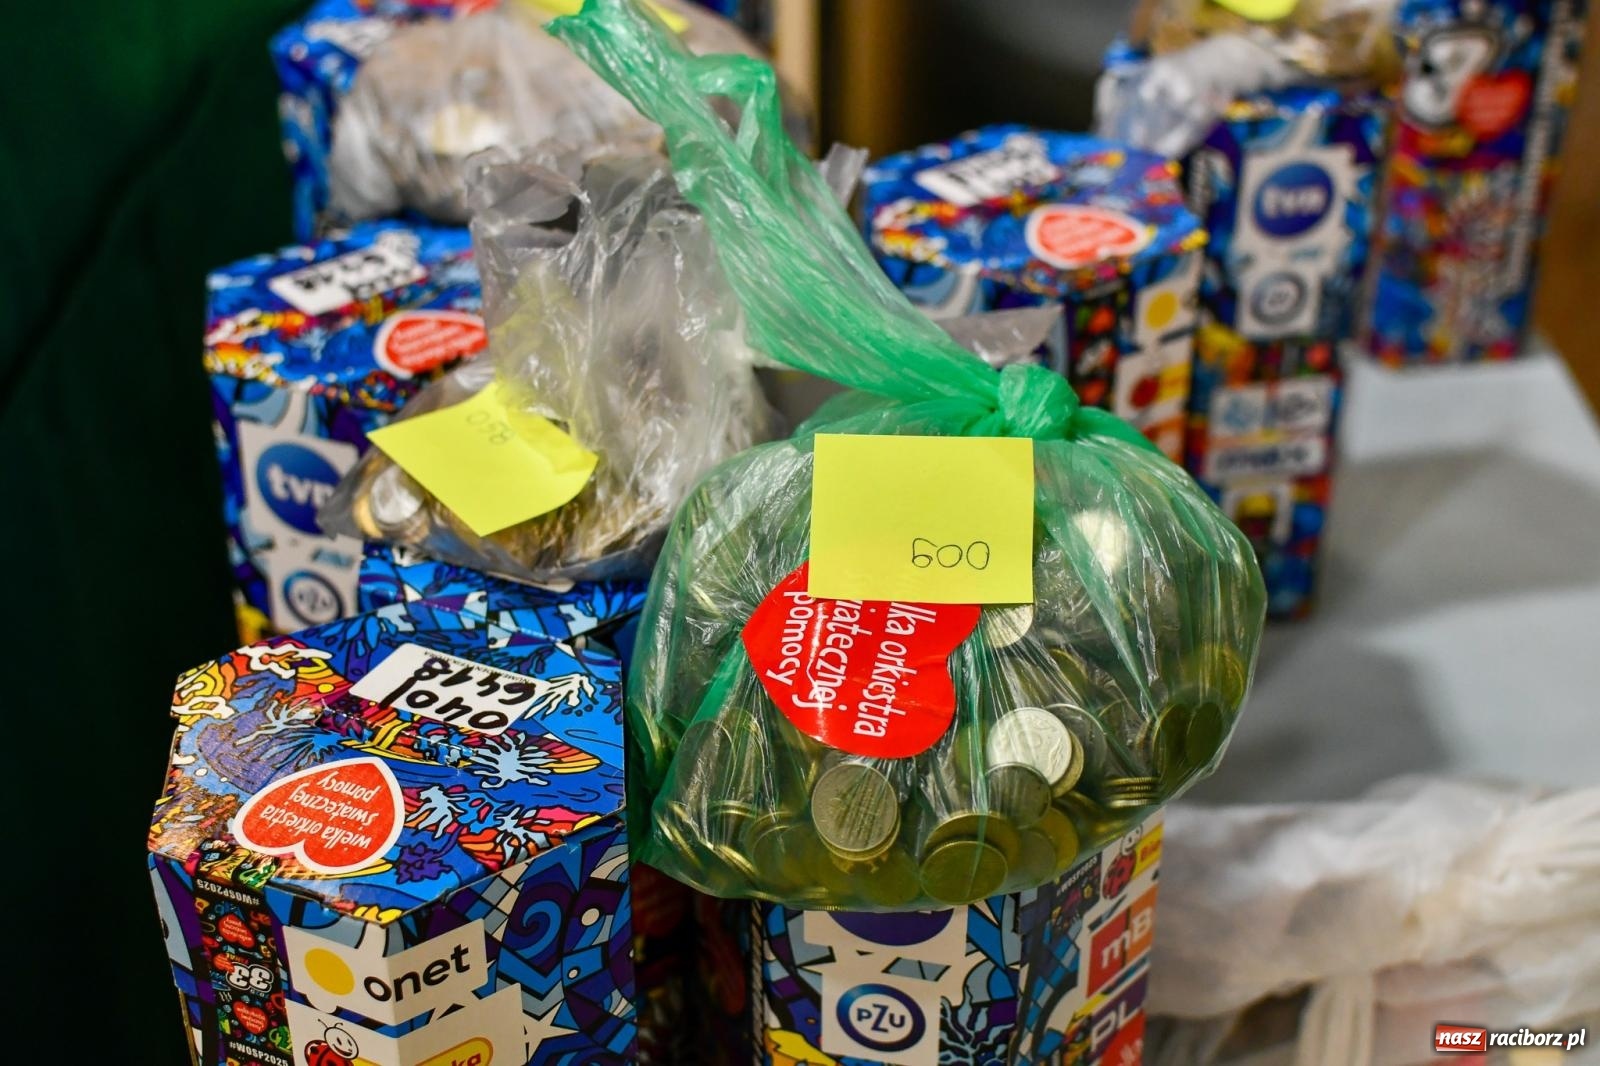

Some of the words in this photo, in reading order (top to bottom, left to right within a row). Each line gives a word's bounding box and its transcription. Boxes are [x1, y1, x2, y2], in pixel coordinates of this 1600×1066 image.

[911, 537, 990, 571] 600
[766, 591, 815, 687] pomocy
[853, 641, 917, 738] orkiestra
[316, 771, 382, 802] pomocy
[259, 805, 323, 836] orkiestra
[284, 783, 380, 831] świątecznej
[319, 825, 373, 852] wielka
[197, 878, 260, 906] #WOSP2025
[363, 943, 471, 1003] onet
[857, 1003, 906, 1034] PZU
